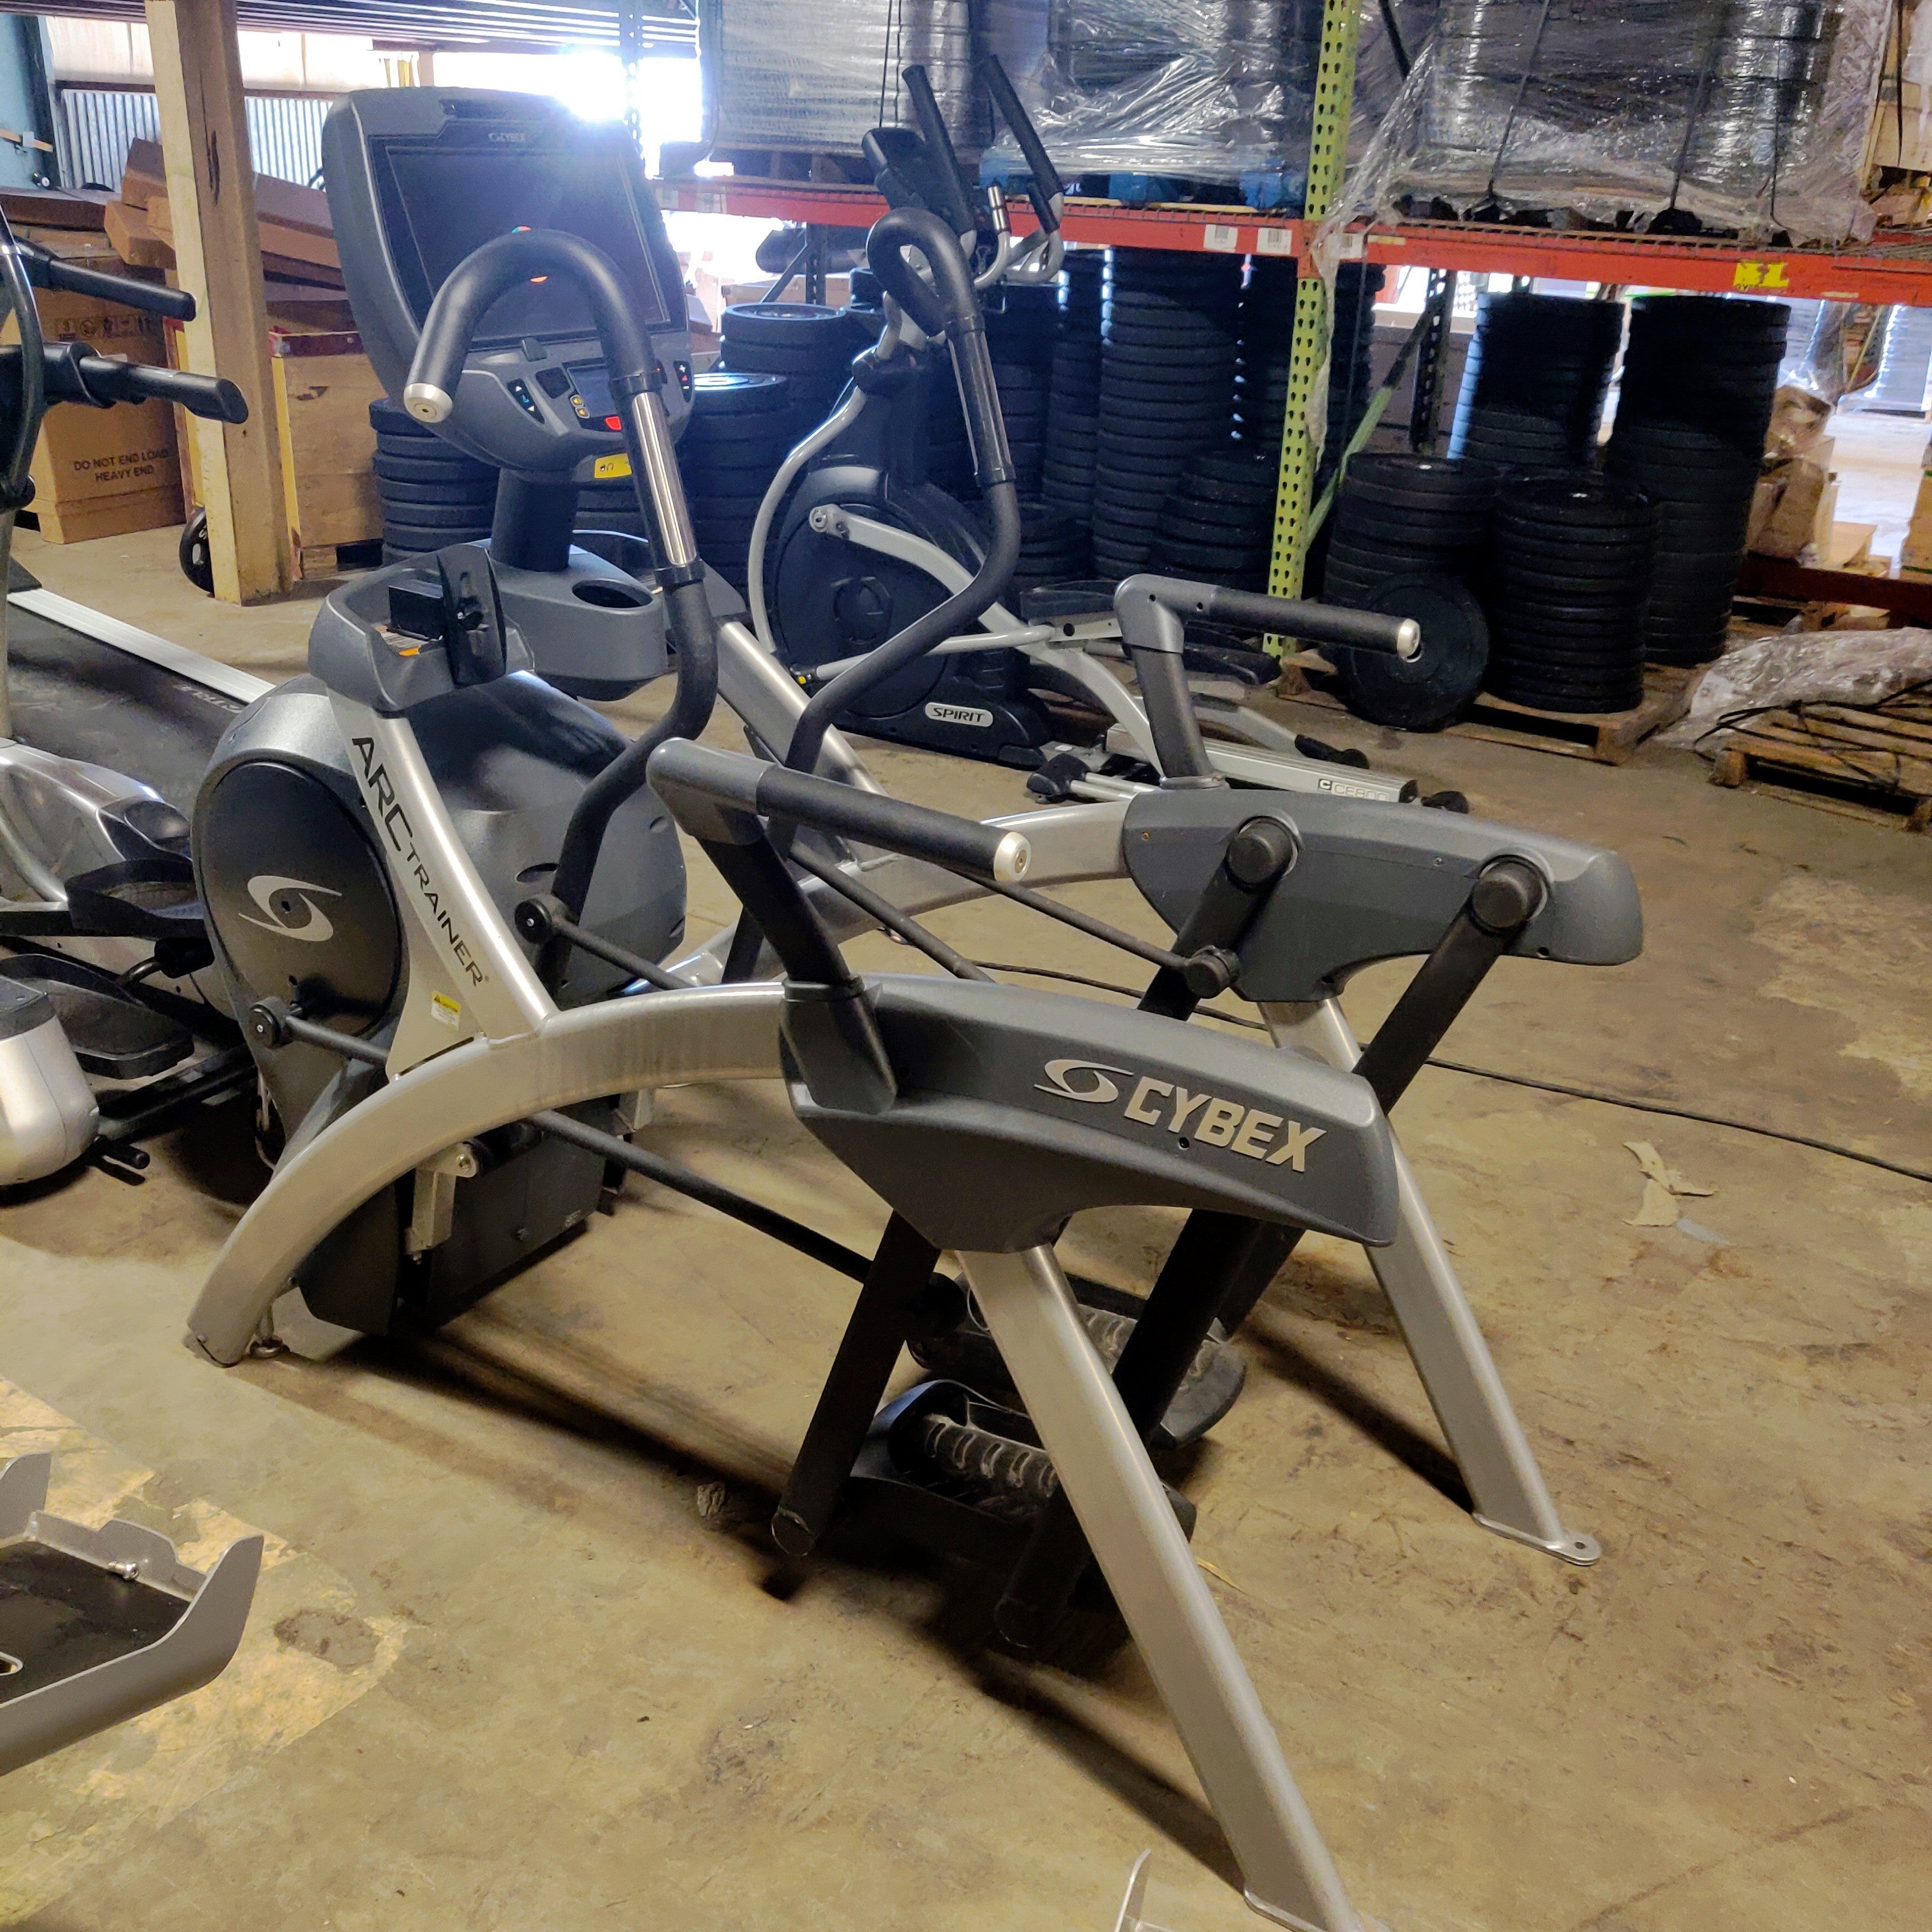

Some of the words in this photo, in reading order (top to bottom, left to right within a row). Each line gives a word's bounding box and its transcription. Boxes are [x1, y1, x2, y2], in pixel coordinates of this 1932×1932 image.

[74, 461, 91, 470] DO
[93, 457, 115, 467] NOT
[119, 453, 139, 465] END
[142, 448, 168, 461] LOAD
[95, 470, 131, 481] HEAVY
[134, 465, 154, 476] END
[931, 708, 985, 722] SPIRIT
[1123, 1076, 1328, 1173] CYBEX
